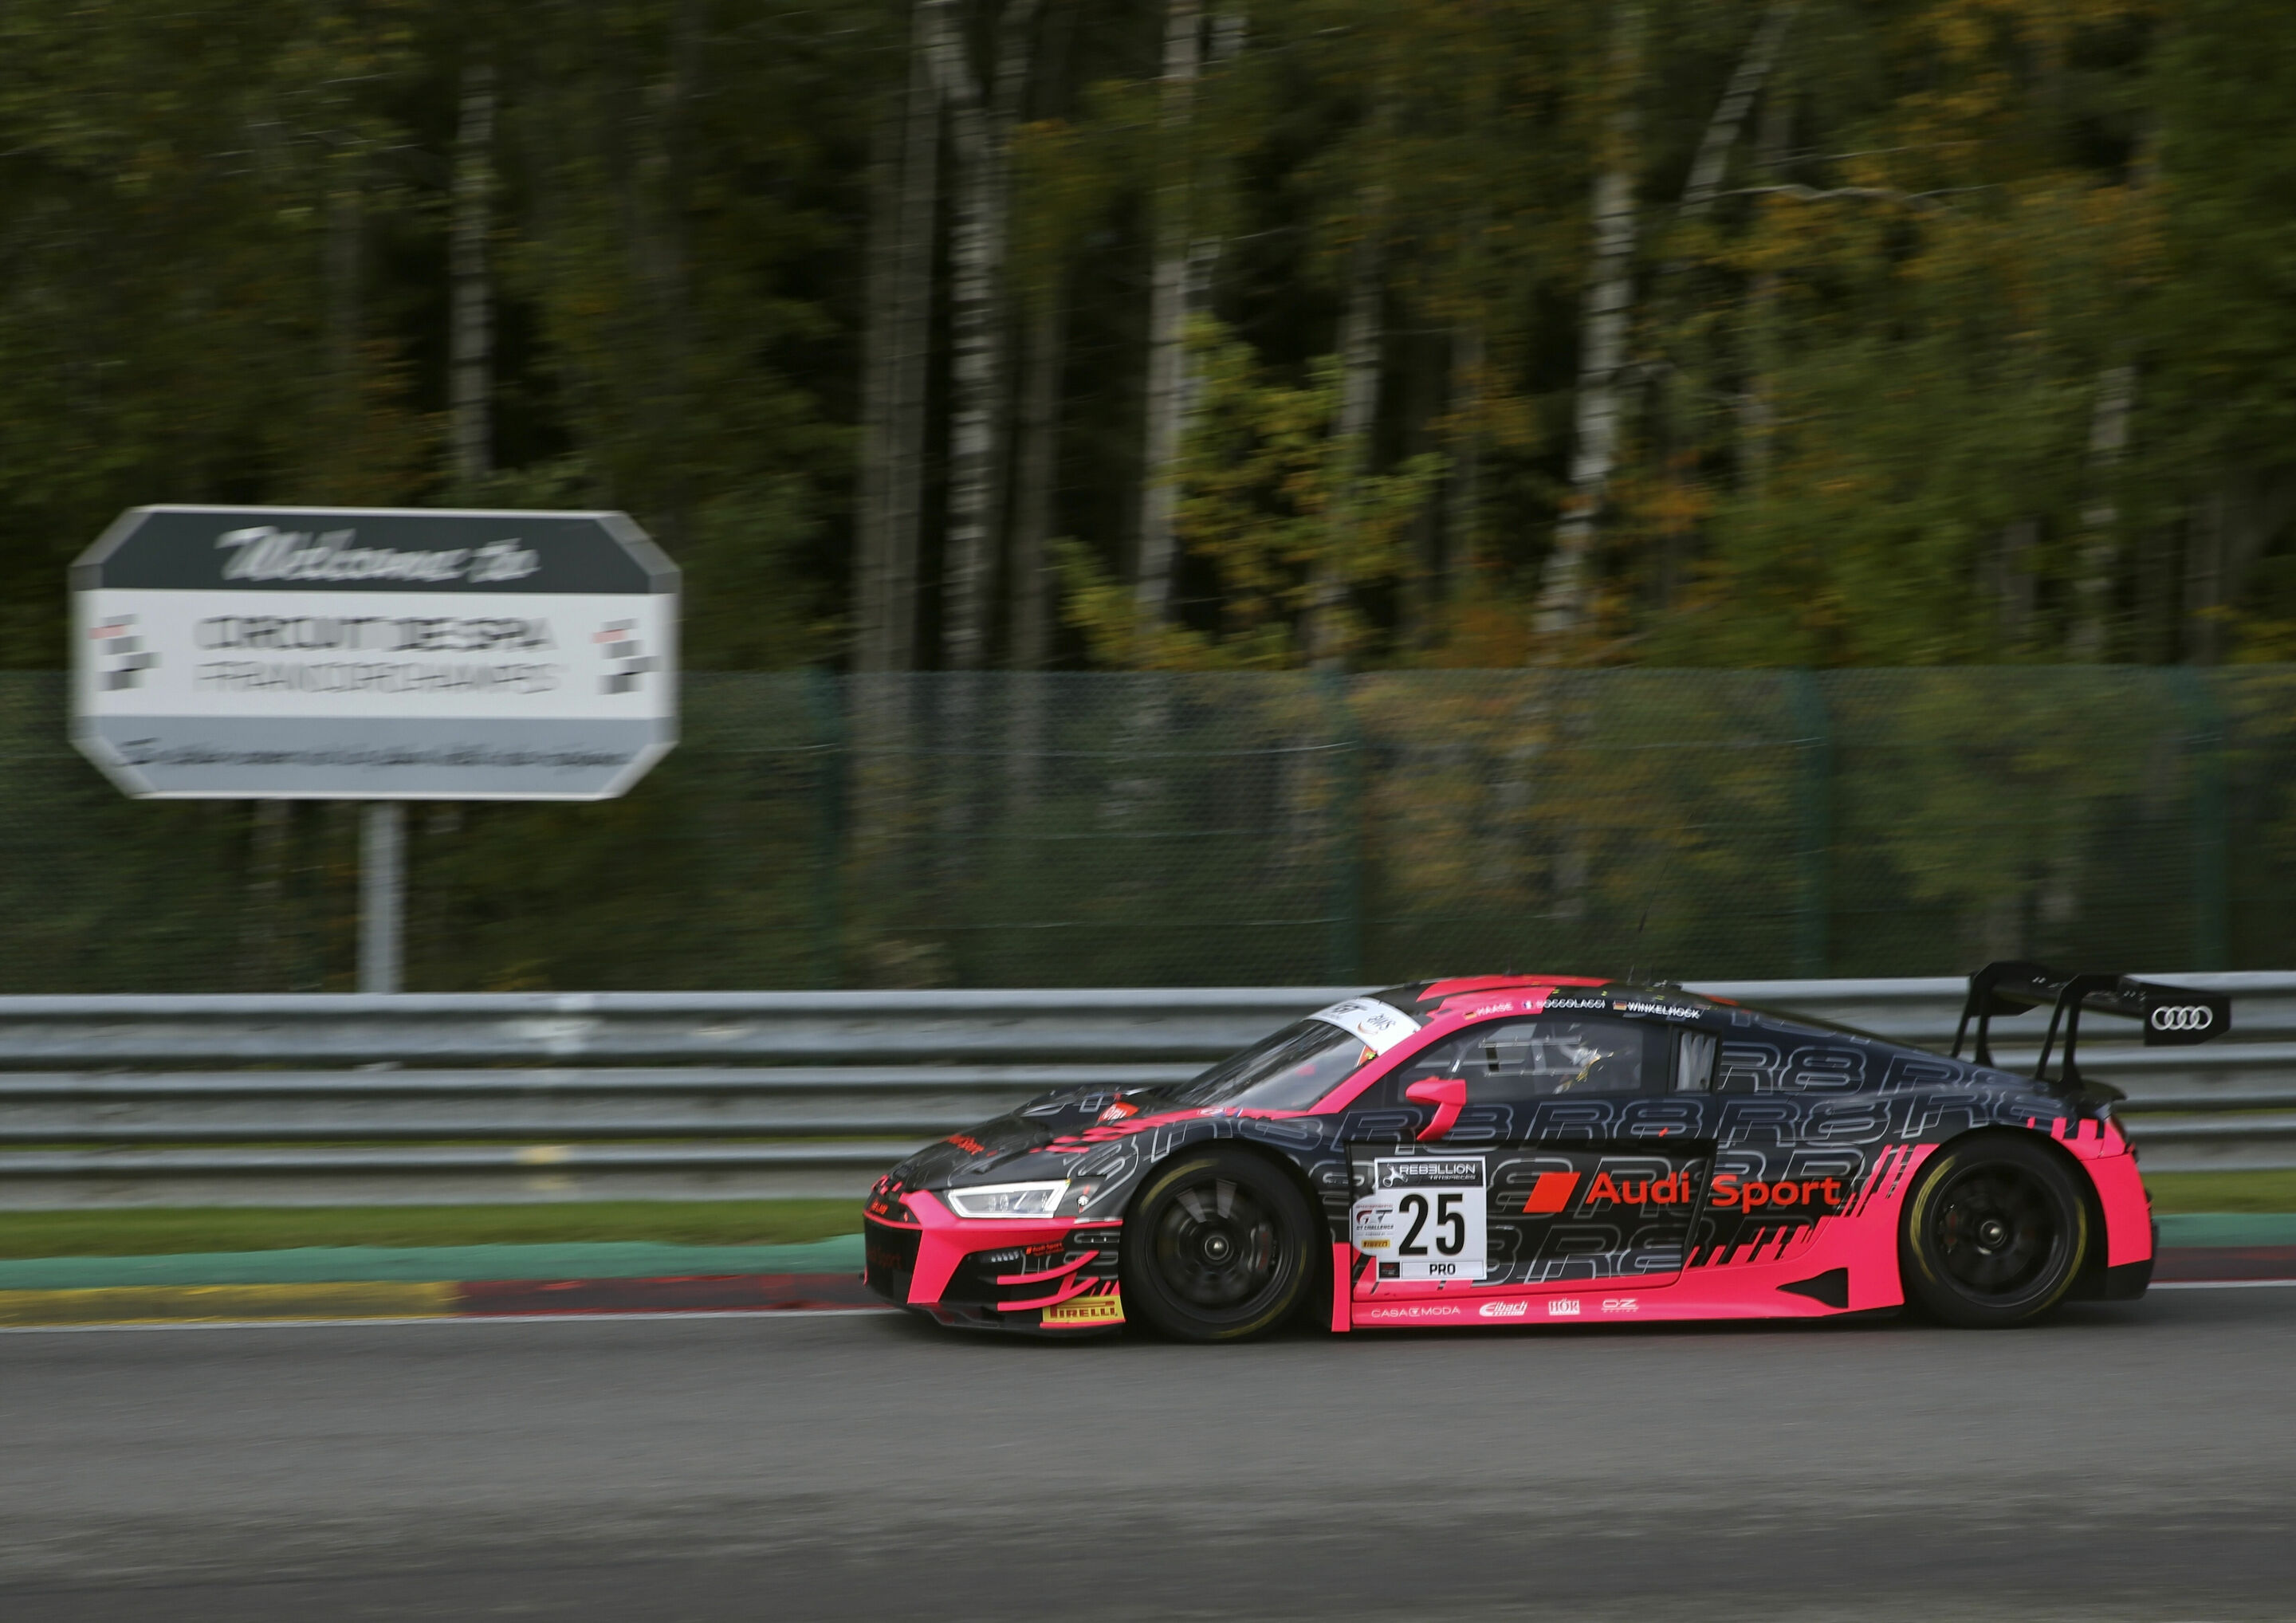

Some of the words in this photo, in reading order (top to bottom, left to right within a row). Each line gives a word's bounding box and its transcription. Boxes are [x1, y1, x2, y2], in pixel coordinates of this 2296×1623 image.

[214, 525, 472, 583] Welcome
[1476, 1002, 1513, 1016] HAASE
[1628, 1002, 1700, 1020] WINKELHOCK
[1399, 1163, 1476, 1175] REBELLION
[1585, 1171, 1690, 1204] Audi
[1712, 1173, 1842, 1214] Sport
[1399, 1193, 1465, 1256] 25
[1429, 1263, 1456, 1275] PRO
[1049, 1301, 1117, 1318] PIRELLI
[1371, 1308, 1409, 1318] CASA
[1421, 1306, 1461, 1316] MODA
[1479, 1300, 1529, 1316] Eibach
